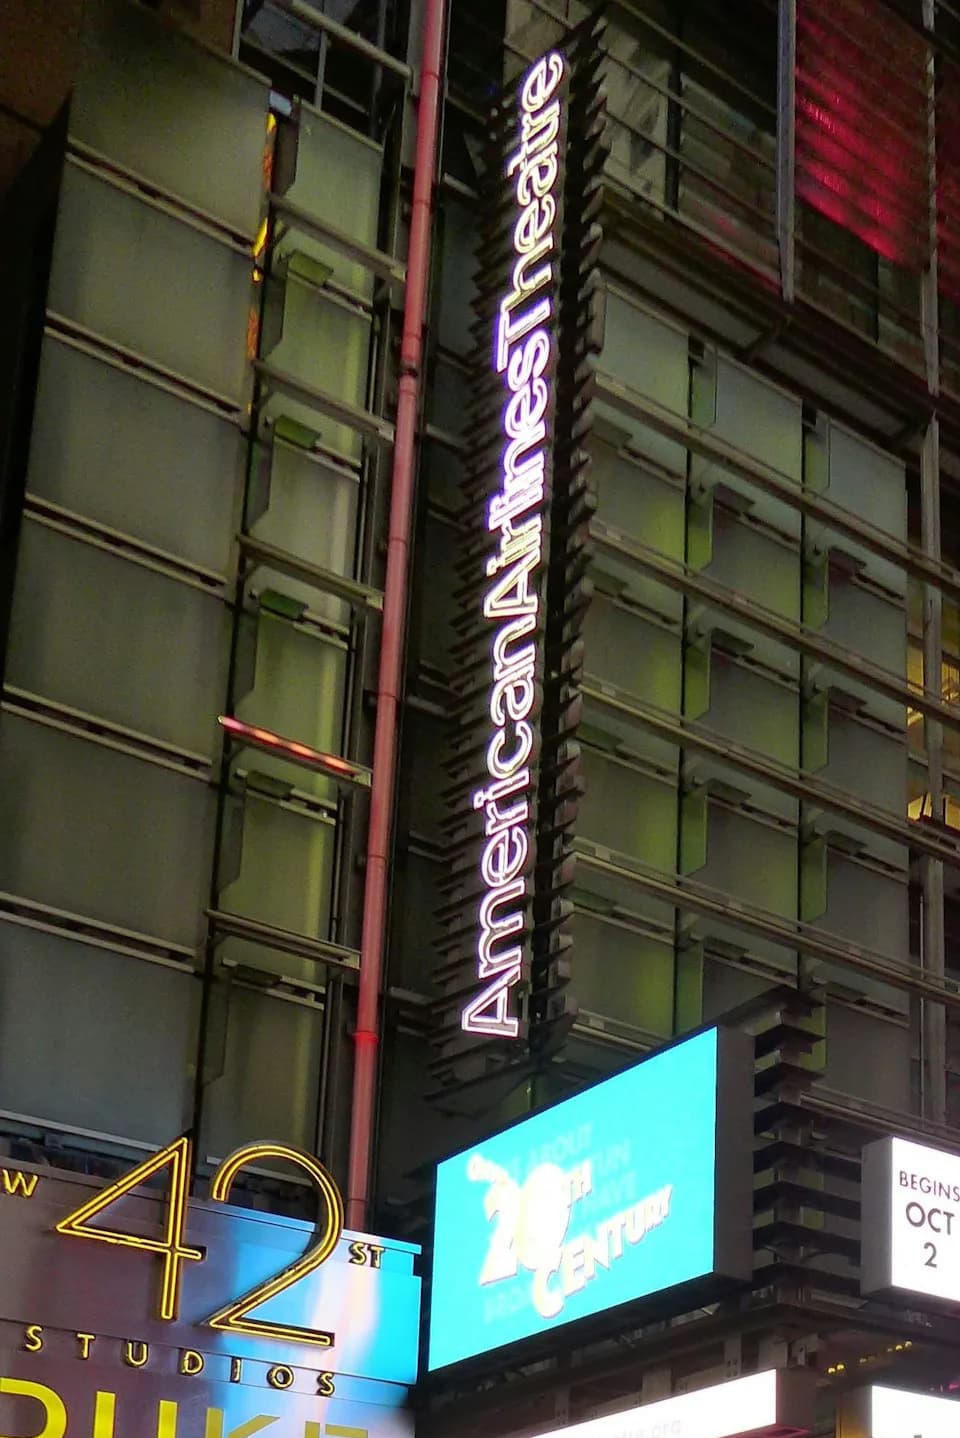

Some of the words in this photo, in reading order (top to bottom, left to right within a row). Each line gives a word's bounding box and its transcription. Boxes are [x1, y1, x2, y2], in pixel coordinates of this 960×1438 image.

[899, 1170, 960, 1202] BEGINS
[905, 1202, 955, 1236] OCT
[56, 1135, 345, 1347] 42
[349, 1241, 386, 1269] ST
[923, 1241, 938, 1269] 2
[23, 1324, 336, 1397] STUDIOS
